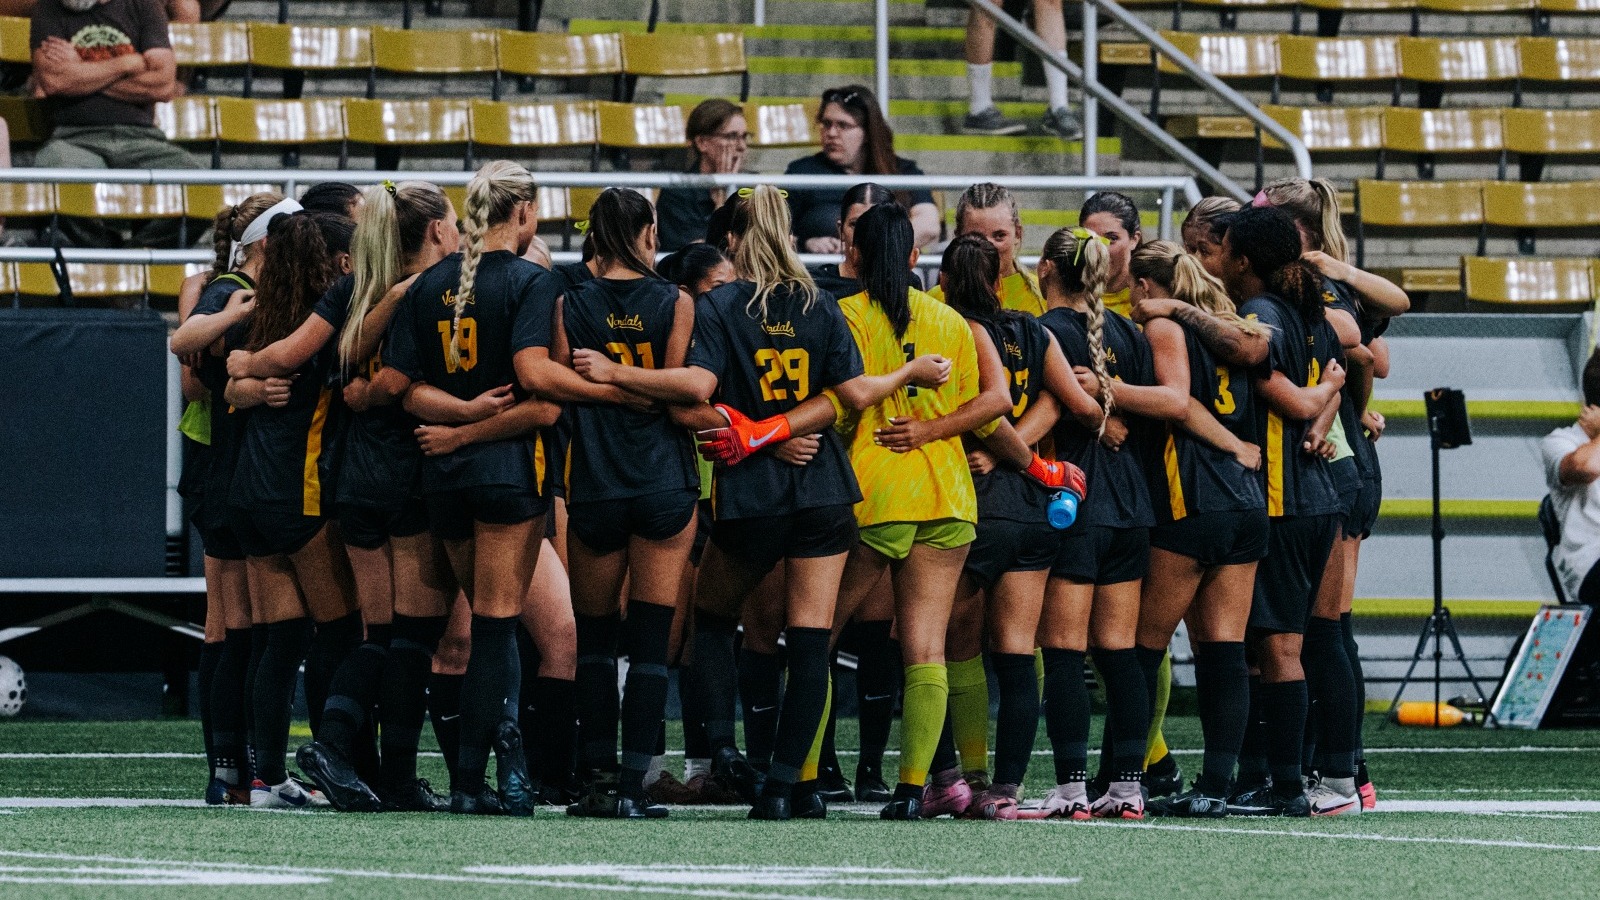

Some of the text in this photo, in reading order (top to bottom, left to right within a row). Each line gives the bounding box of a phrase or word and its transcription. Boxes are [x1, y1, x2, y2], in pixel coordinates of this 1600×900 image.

[437, 317, 478, 374] 19
[754, 347, 809, 402] 29
[1214, 366, 1236, 414] 3
